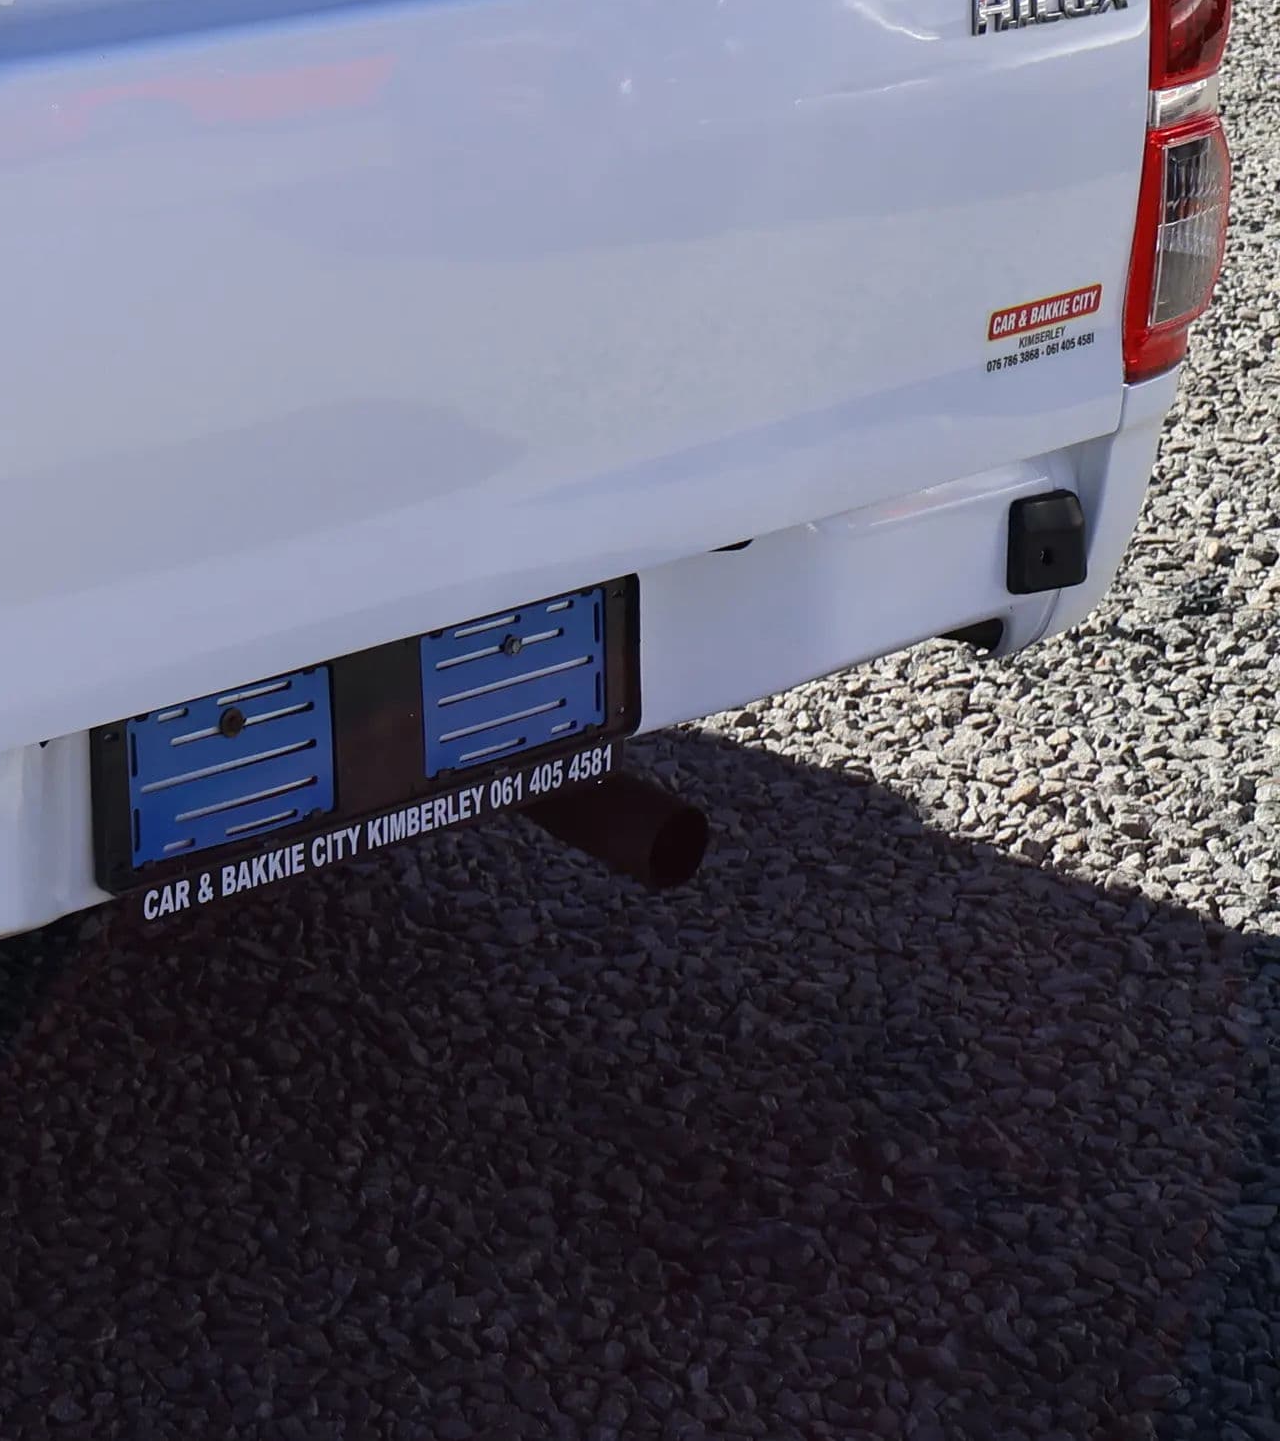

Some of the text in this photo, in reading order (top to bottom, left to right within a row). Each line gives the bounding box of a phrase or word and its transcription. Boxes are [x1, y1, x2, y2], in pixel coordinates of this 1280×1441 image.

[993, 290, 1098, 335] CAR & BAKKIE CITY
[986, 358, 1002, 373] 076
[1046, 342, 1060, 357] 061
[1060, 337, 1076, 352] 405
[1076, 332, 1095, 347] 4581
[1018, 325, 1067, 349] KIMBERLEY
[143, 742, 613, 921] CAR & BAKKIE CITY KIMBERLEY 061 405 4581
